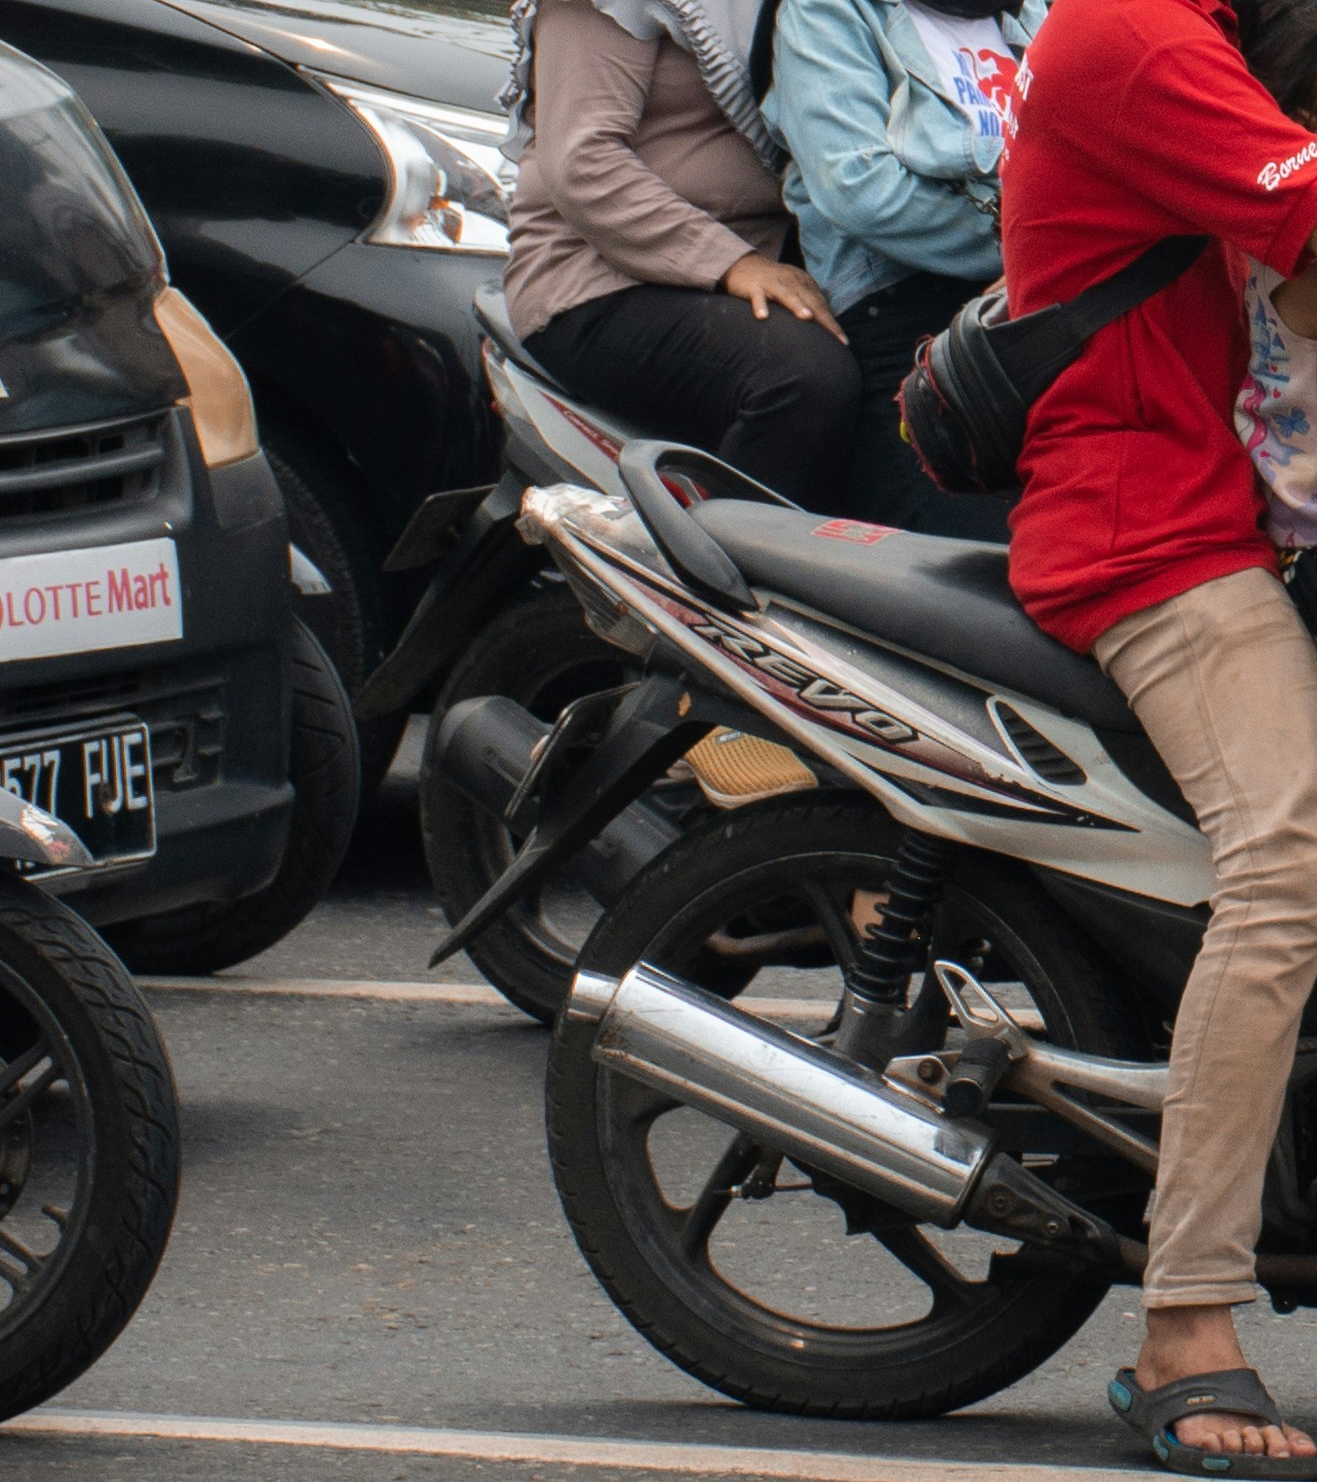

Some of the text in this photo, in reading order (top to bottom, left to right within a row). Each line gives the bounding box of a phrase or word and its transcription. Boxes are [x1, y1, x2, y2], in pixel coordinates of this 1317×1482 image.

[5, 562, 172, 627] LOTTE Mart
[691, 612, 918, 742] REVO
